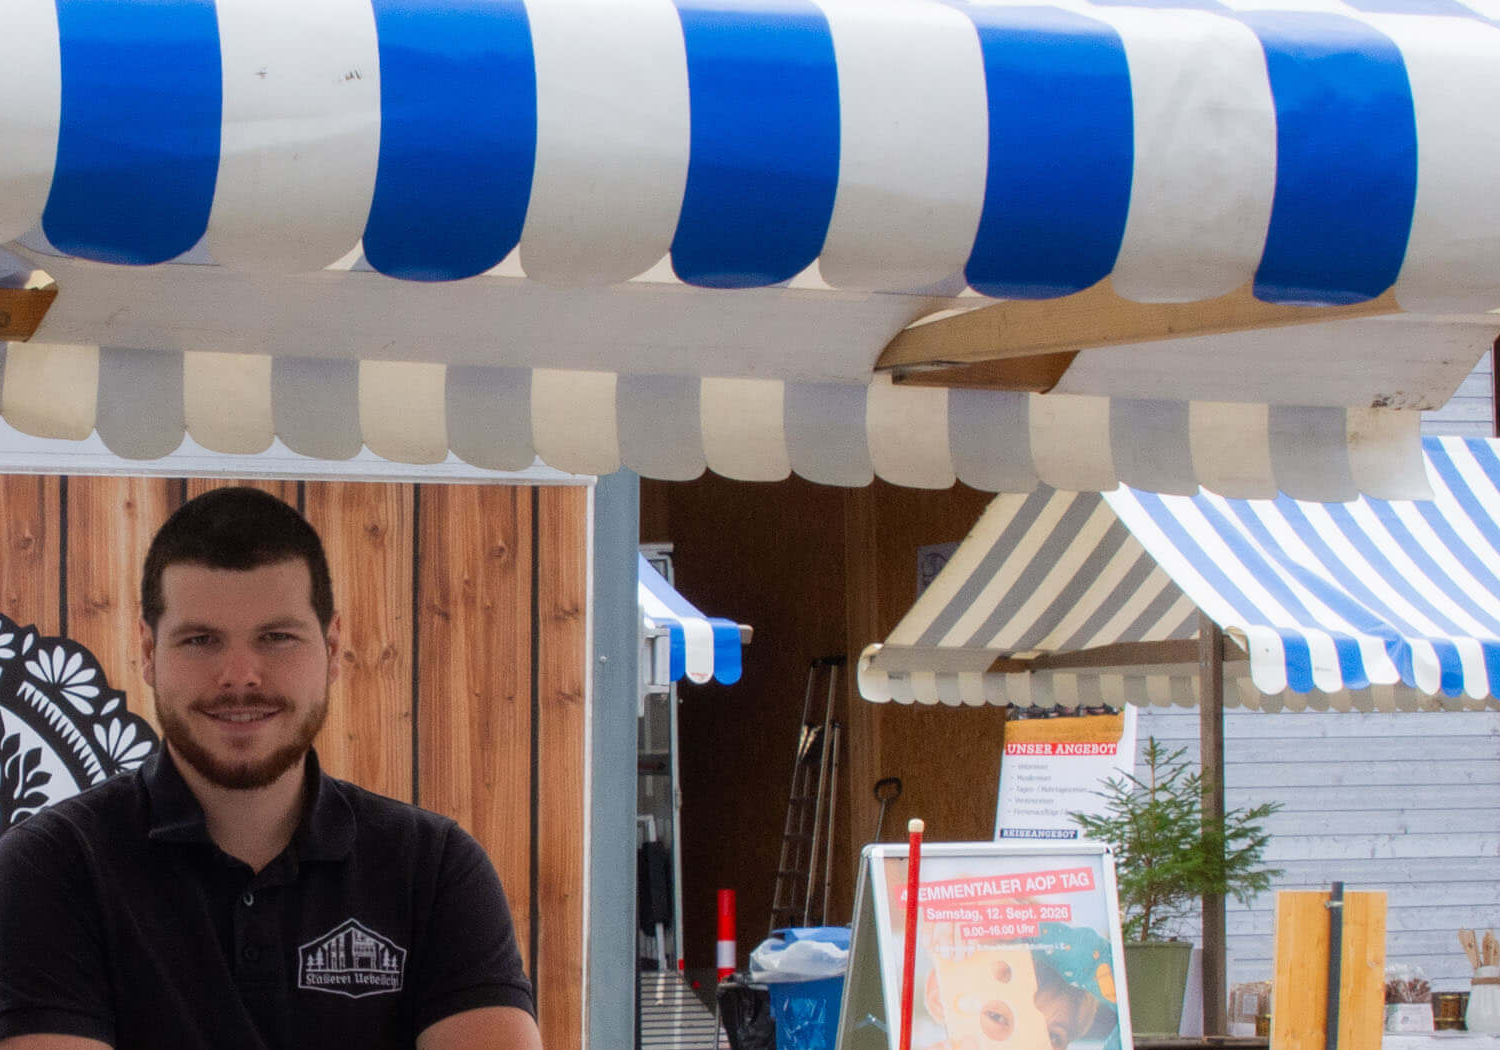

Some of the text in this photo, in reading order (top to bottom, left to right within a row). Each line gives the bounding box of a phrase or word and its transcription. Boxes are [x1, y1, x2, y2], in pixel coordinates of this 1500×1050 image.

[1007, 743, 1117, 755] UNSER ANGEBOT
[918, 879, 1022, 900] EMMENTALER
[1026, 875, 1057, 892] AOP
[1060, 871, 1090, 889] TAG
[926, 908, 983, 922] Samstag,
[987, 908, 1003, 920] 12.
[1006, 907, 1037, 922] Sept.
[1017, 924, 1036, 935] Uhr
